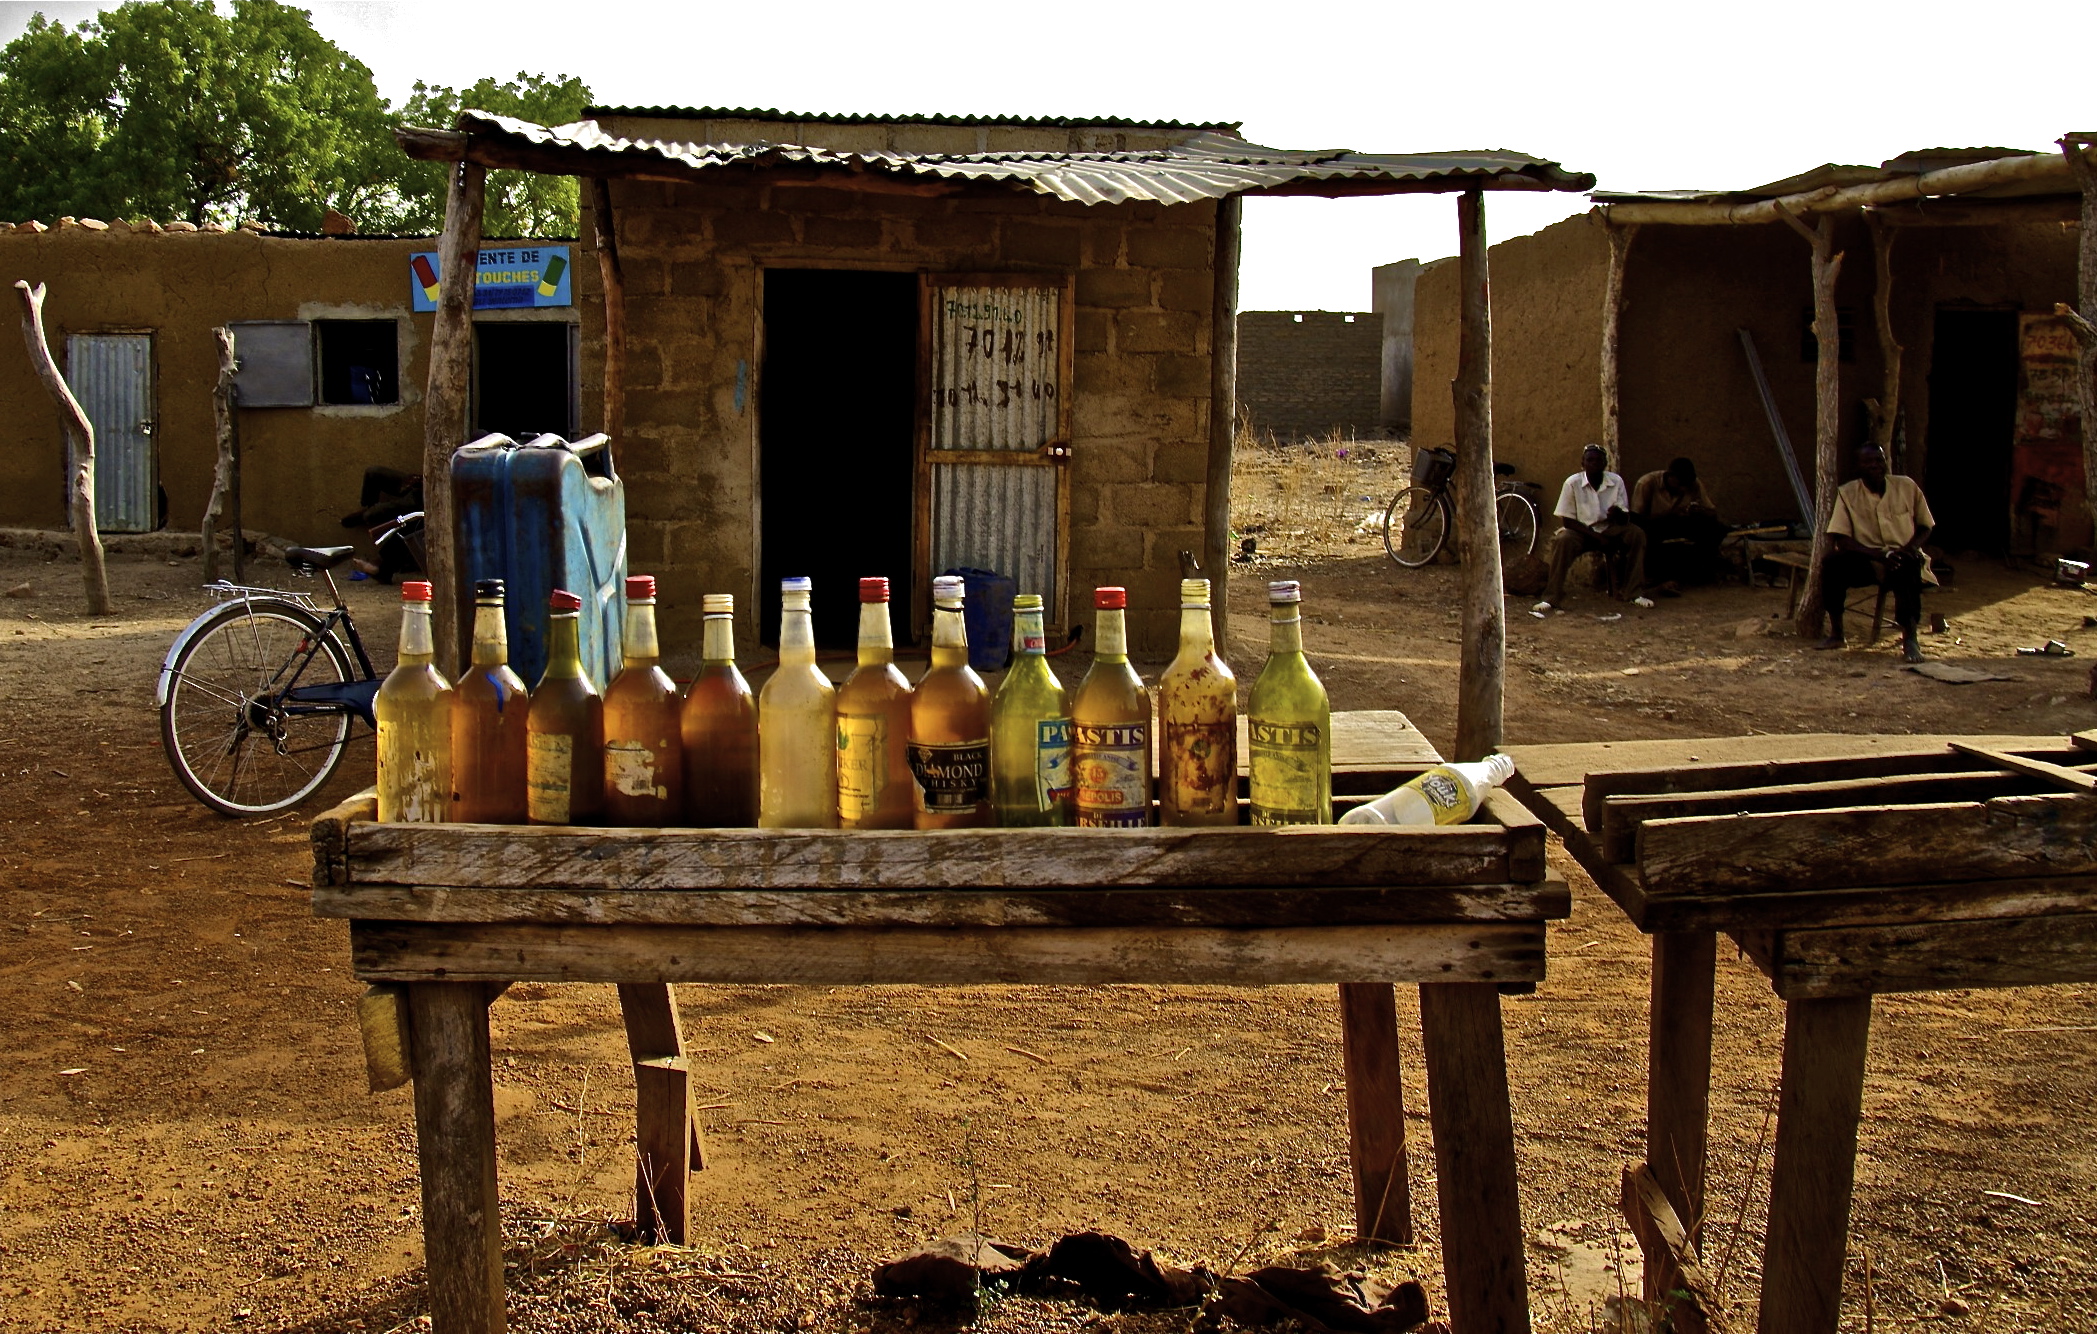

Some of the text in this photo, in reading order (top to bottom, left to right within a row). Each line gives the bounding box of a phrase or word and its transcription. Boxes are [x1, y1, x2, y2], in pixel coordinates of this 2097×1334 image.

[479, 251, 539, 265] ENTE DE
[476, 270, 540, 284] TOUCHES
[963, 326, 994, 359] 70
[1042, 725, 1072, 743] PA
[1075, 726, 1145, 746] ASTIS
[1250, 723, 1317, 745] ASTIS
[953, 753, 983, 762] BLACK
[915, 763, 983, 780] DIAMOND
